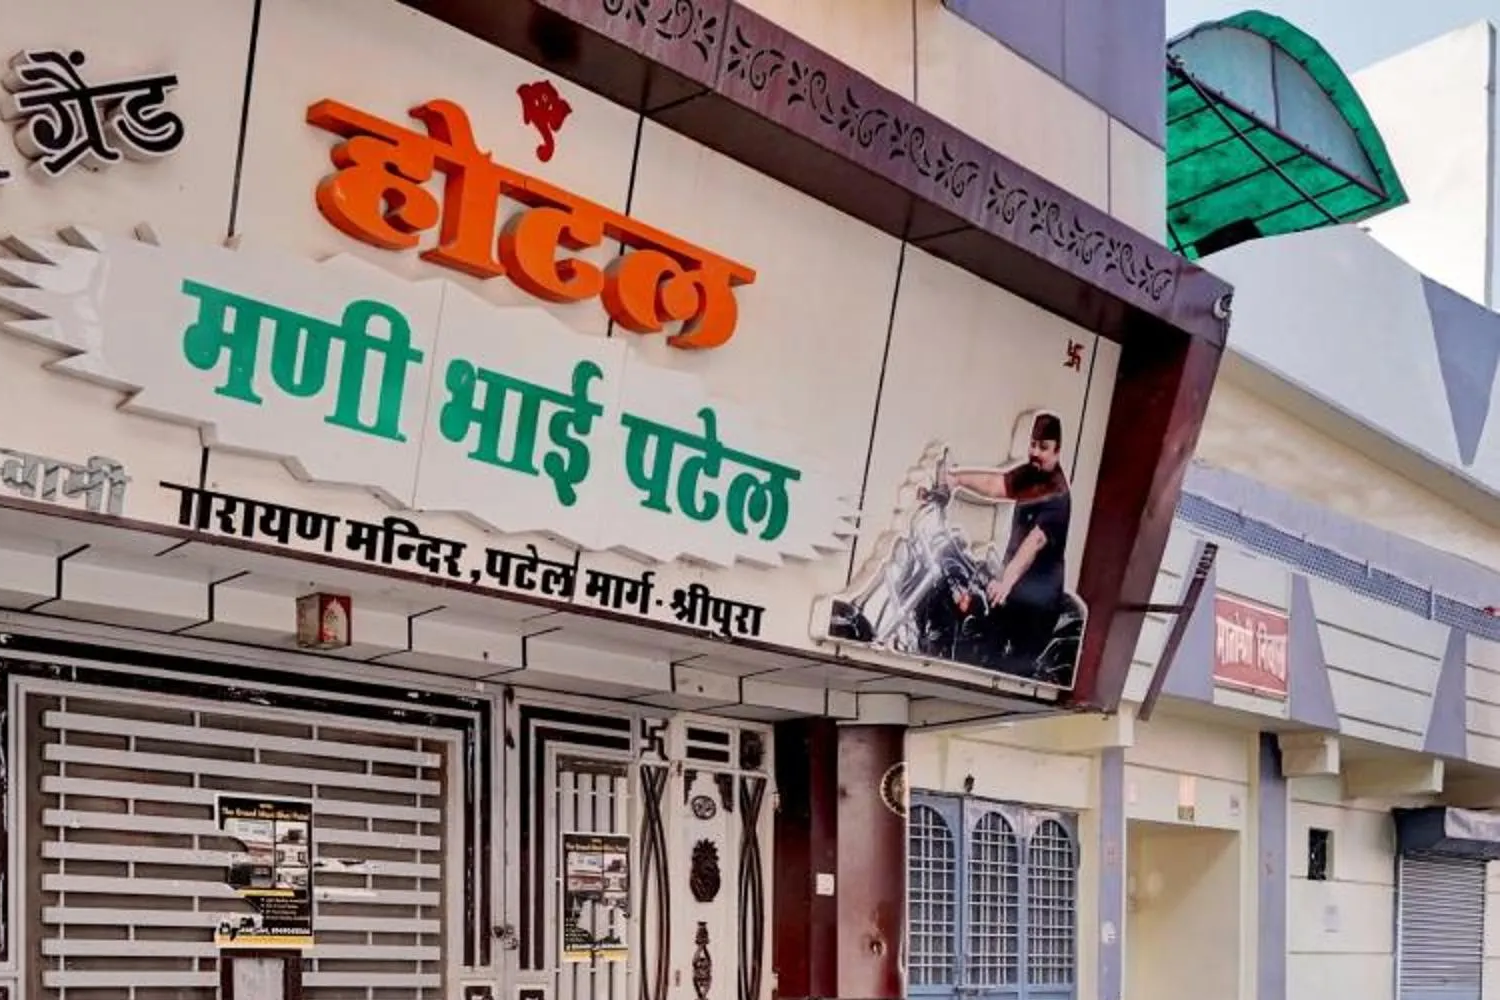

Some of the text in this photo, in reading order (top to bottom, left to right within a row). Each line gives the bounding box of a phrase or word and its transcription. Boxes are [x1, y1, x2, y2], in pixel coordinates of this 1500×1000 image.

[13, 50, 185, 177] ग्रैंड
[306, 97, 757, 351] होटल
[181, 279, 802, 542] मणी भाई पटेल
[484, 544, 577, 597] पटेल
